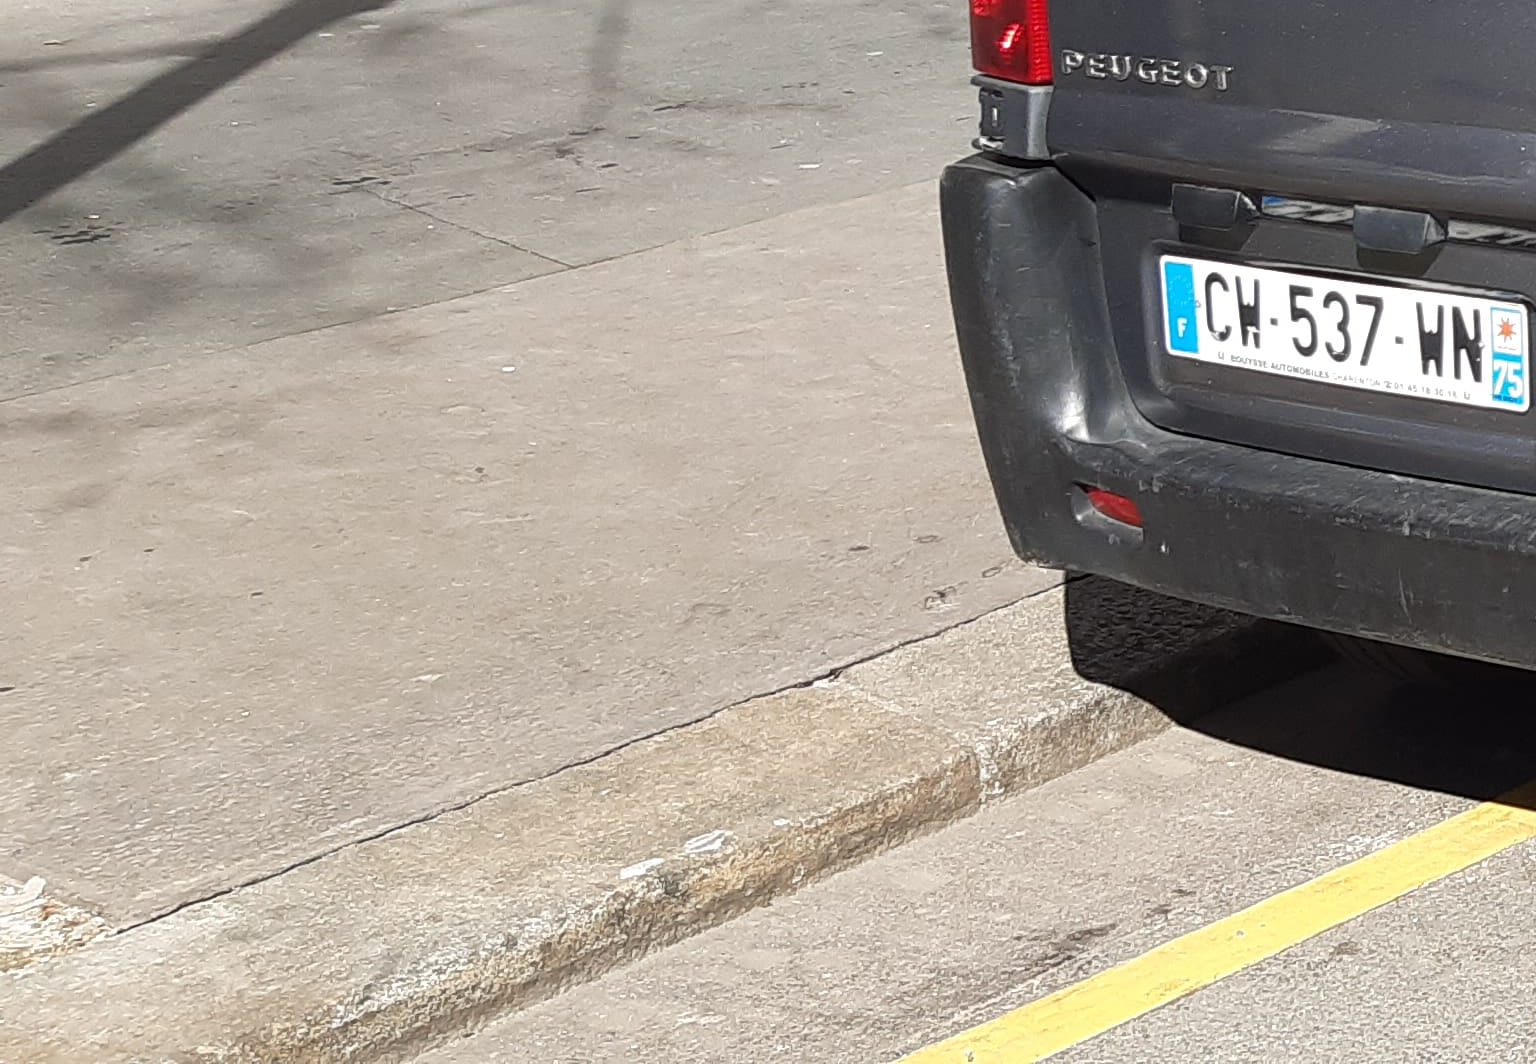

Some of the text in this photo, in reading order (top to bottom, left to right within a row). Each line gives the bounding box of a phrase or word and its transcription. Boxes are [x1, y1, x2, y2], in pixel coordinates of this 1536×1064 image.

[1060, 49, 1234, 91] PEUGEOT
[1176, 317, 1189, 338] F
[1493, 358, 1523, 400] 75
